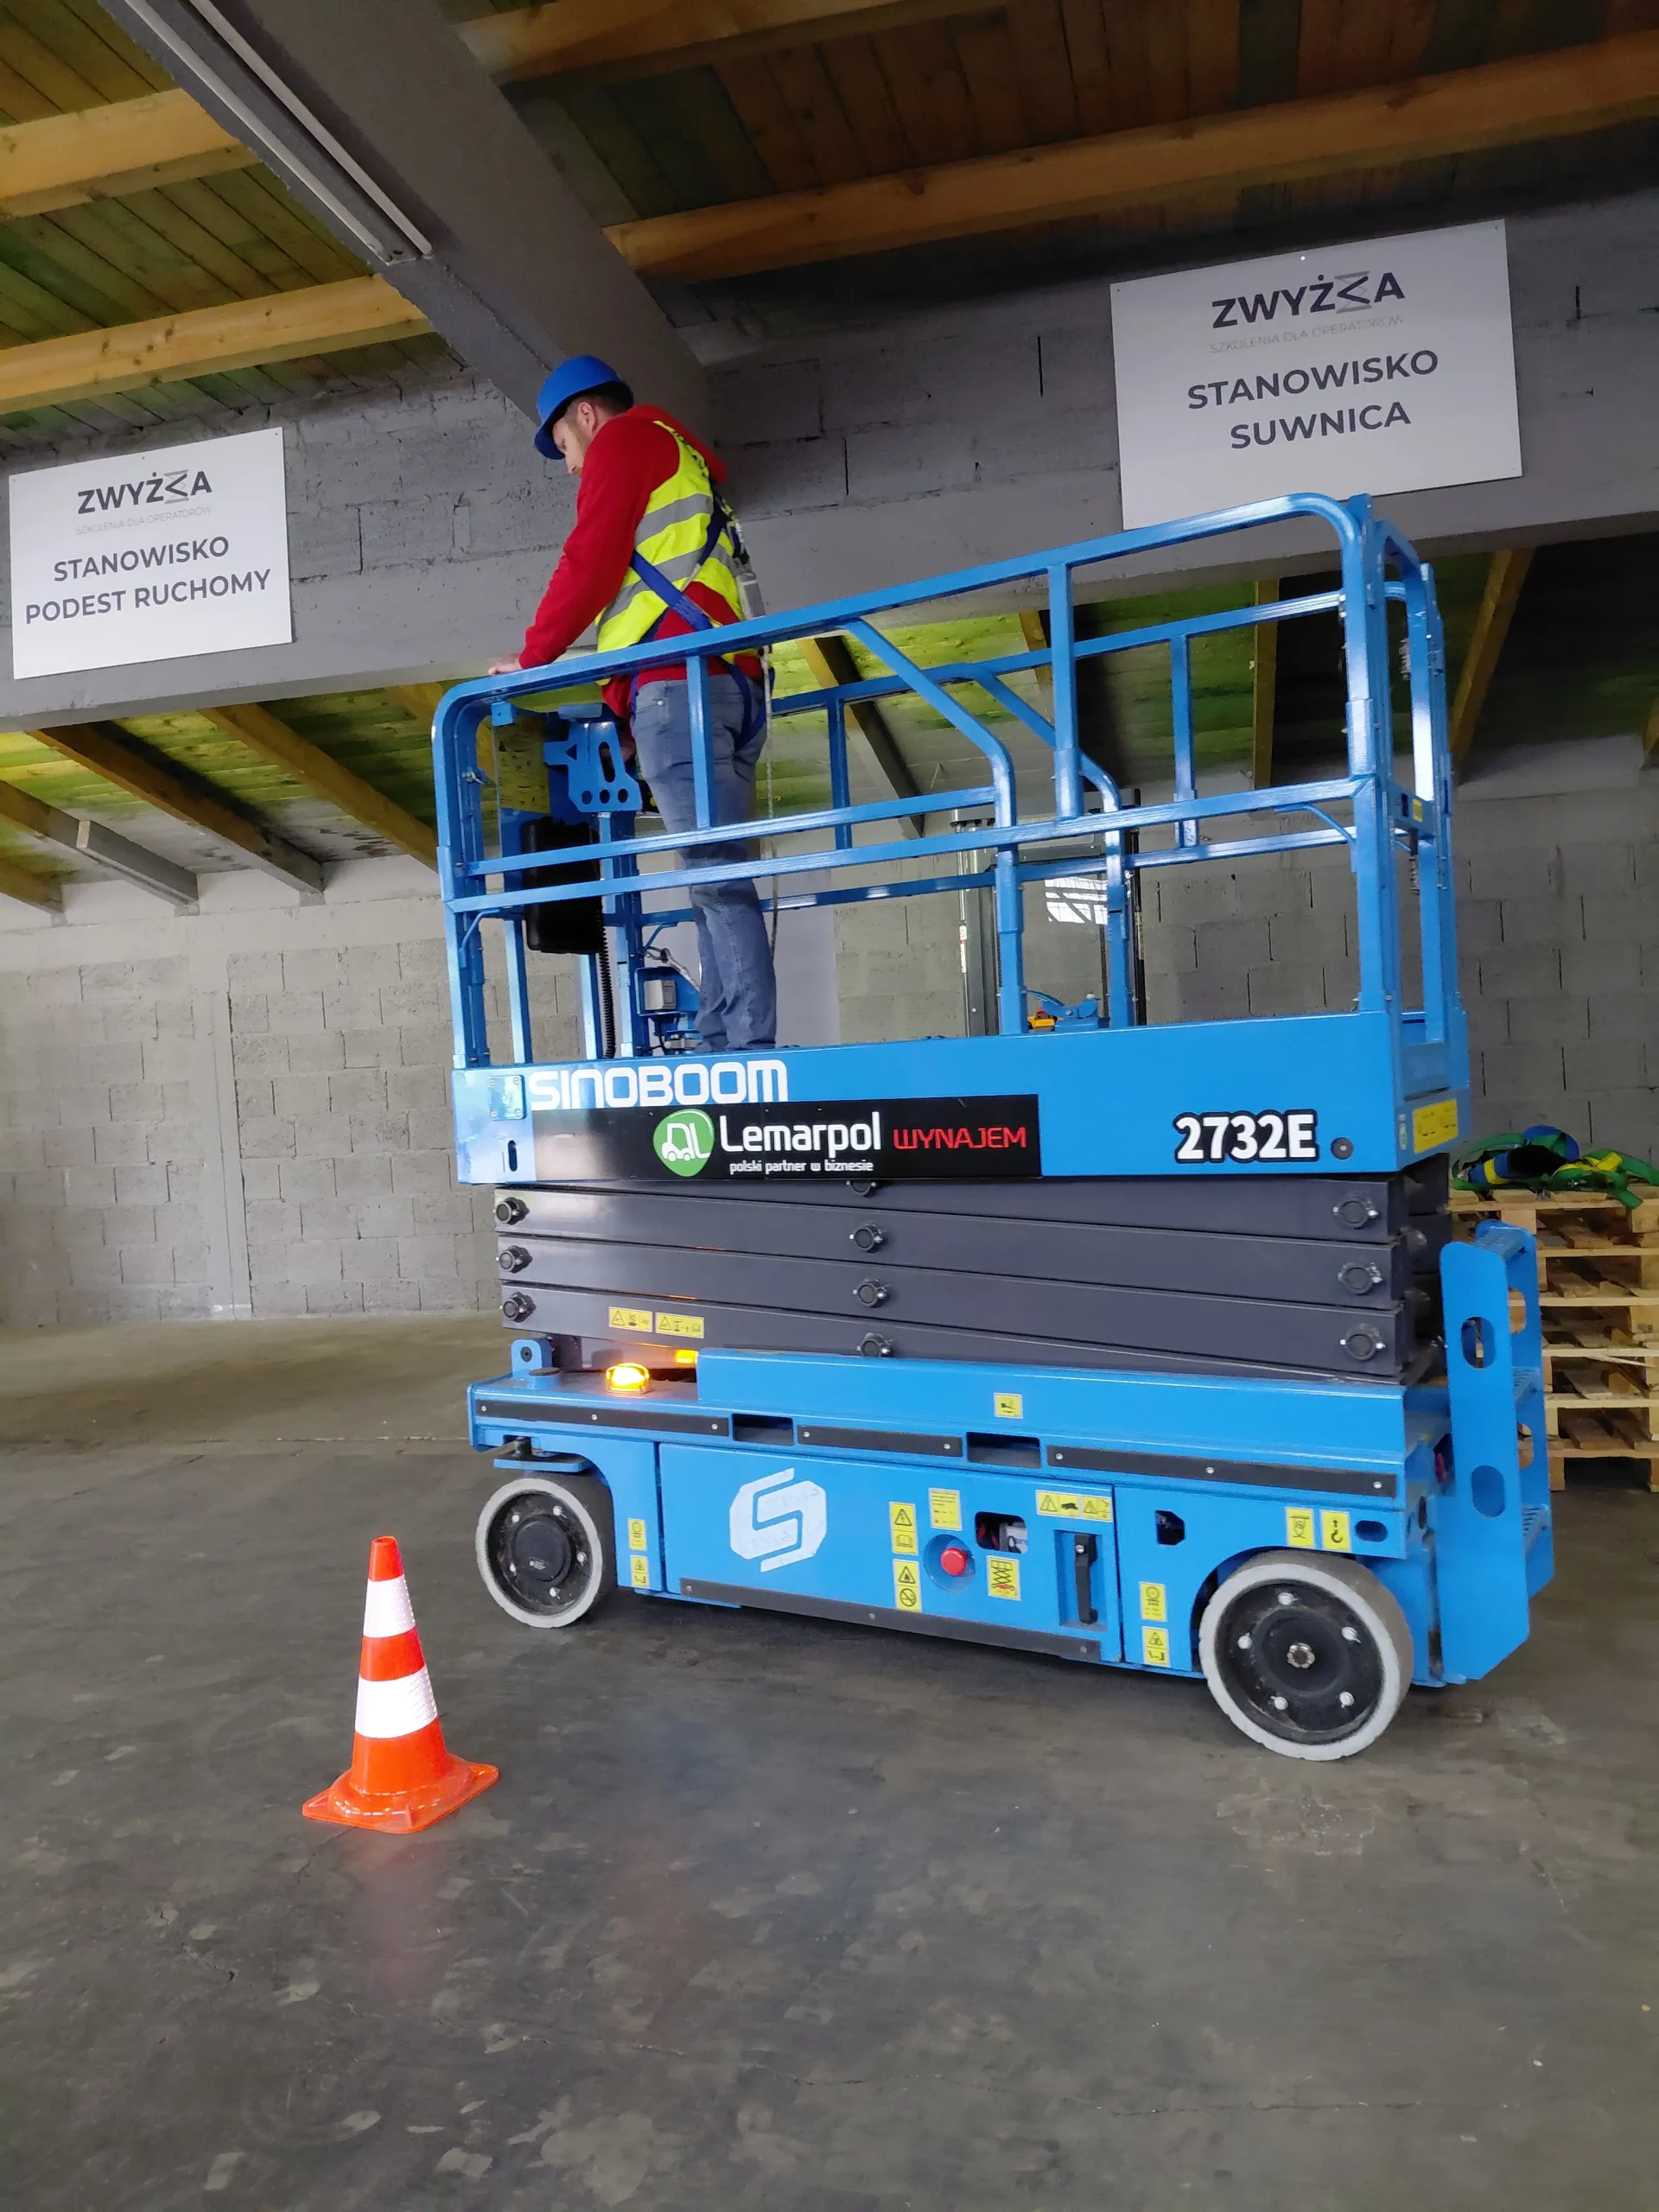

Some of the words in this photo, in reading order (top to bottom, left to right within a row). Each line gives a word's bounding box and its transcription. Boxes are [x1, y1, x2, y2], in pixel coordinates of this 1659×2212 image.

[1284, 330, 1308, 341] DLA
[1188, 350, 1439, 410] STANOWISKO
[1230, 402, 1411, 449] SUWNICA
[54, 536, 230, 582] STANOWISKO
[25, 590, 126, 625] PODEST
[135, 569, 271, 608] RUCHOMY
[719, 1111, 881, 1158] Lemarpol
[893, 1126, 1027, 1150] WYNAJEM
[1173, 1109, 1319, 1163] 2732E
[729, 1159, 762, 1175] polski
[766, 1160, 807, 1174] partner
[824, 1158, 874, 1173] biznesie
